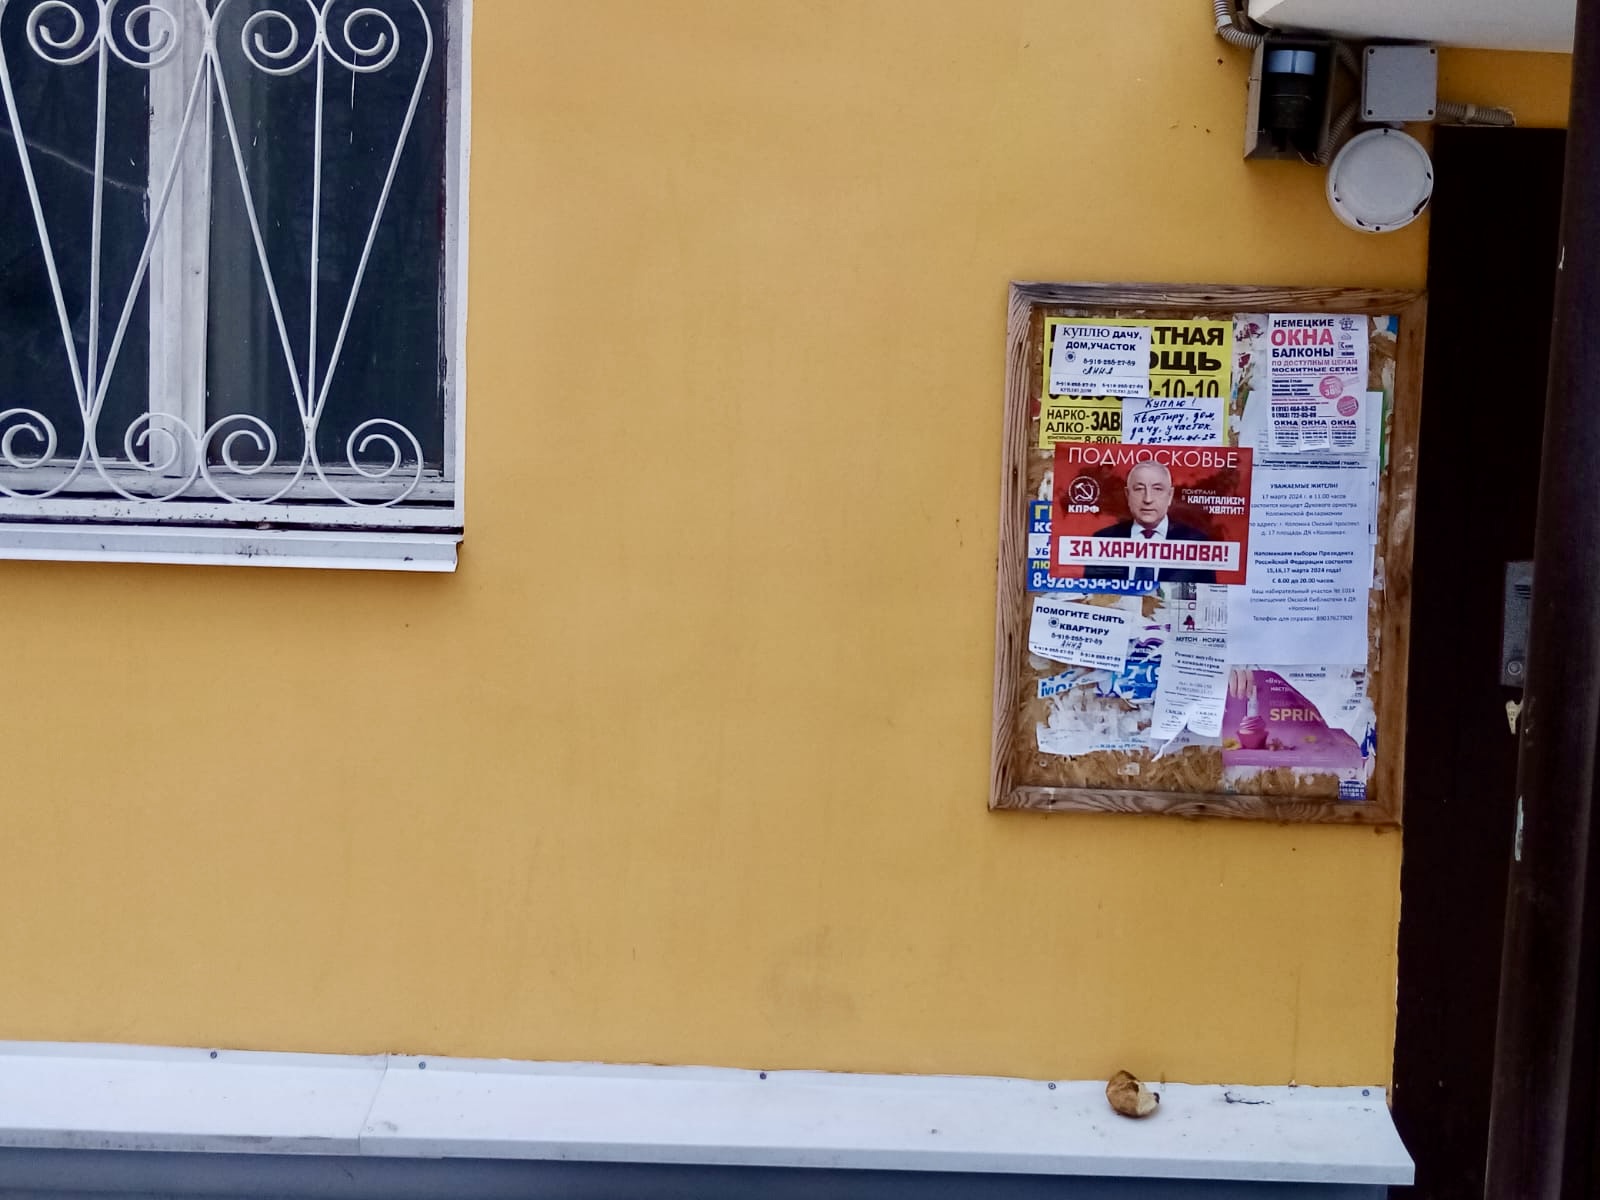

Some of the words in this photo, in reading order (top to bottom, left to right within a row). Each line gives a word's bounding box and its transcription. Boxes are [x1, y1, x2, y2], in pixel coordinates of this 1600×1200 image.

[1273, 319, 1335, 328] НЕМЕЦКИЕ
[1063, 327, 1110, 338] КУПЛЮ
[1112, 330, 1142, 340] ДАЧУ,
[1270, 328, 1334, 346] ОКНА
[1272, 347, 1334, 358] БАЛКОНЫ
[1283, 359, 1330, 367] ДОСТУПНЫМ
[1047, 409, 1089, 421] НАРКО-
[1091, 411, 1122, 431] ЗАВ
[1068, 446, 1237, 468] ПОДМОСКОВЬЕ
[1187, 495, 1246, 505] КАПИТАЛИЗМ
[1068, 504, 1100, 513] КПРФ
[1208, 505, 1245, 515] ХВАТИТ!
[1069, 540, 1093, 557] ЗА
[1099, 541, 1229, 562] ХАРИТОНОВА!
[1035, 606, 1089, 620] ПОМОГИТЕ
[1091, 613, 1125, 625] СНЯТЬ
[1059, 623, 1109, 636] КВАРТИРУ
